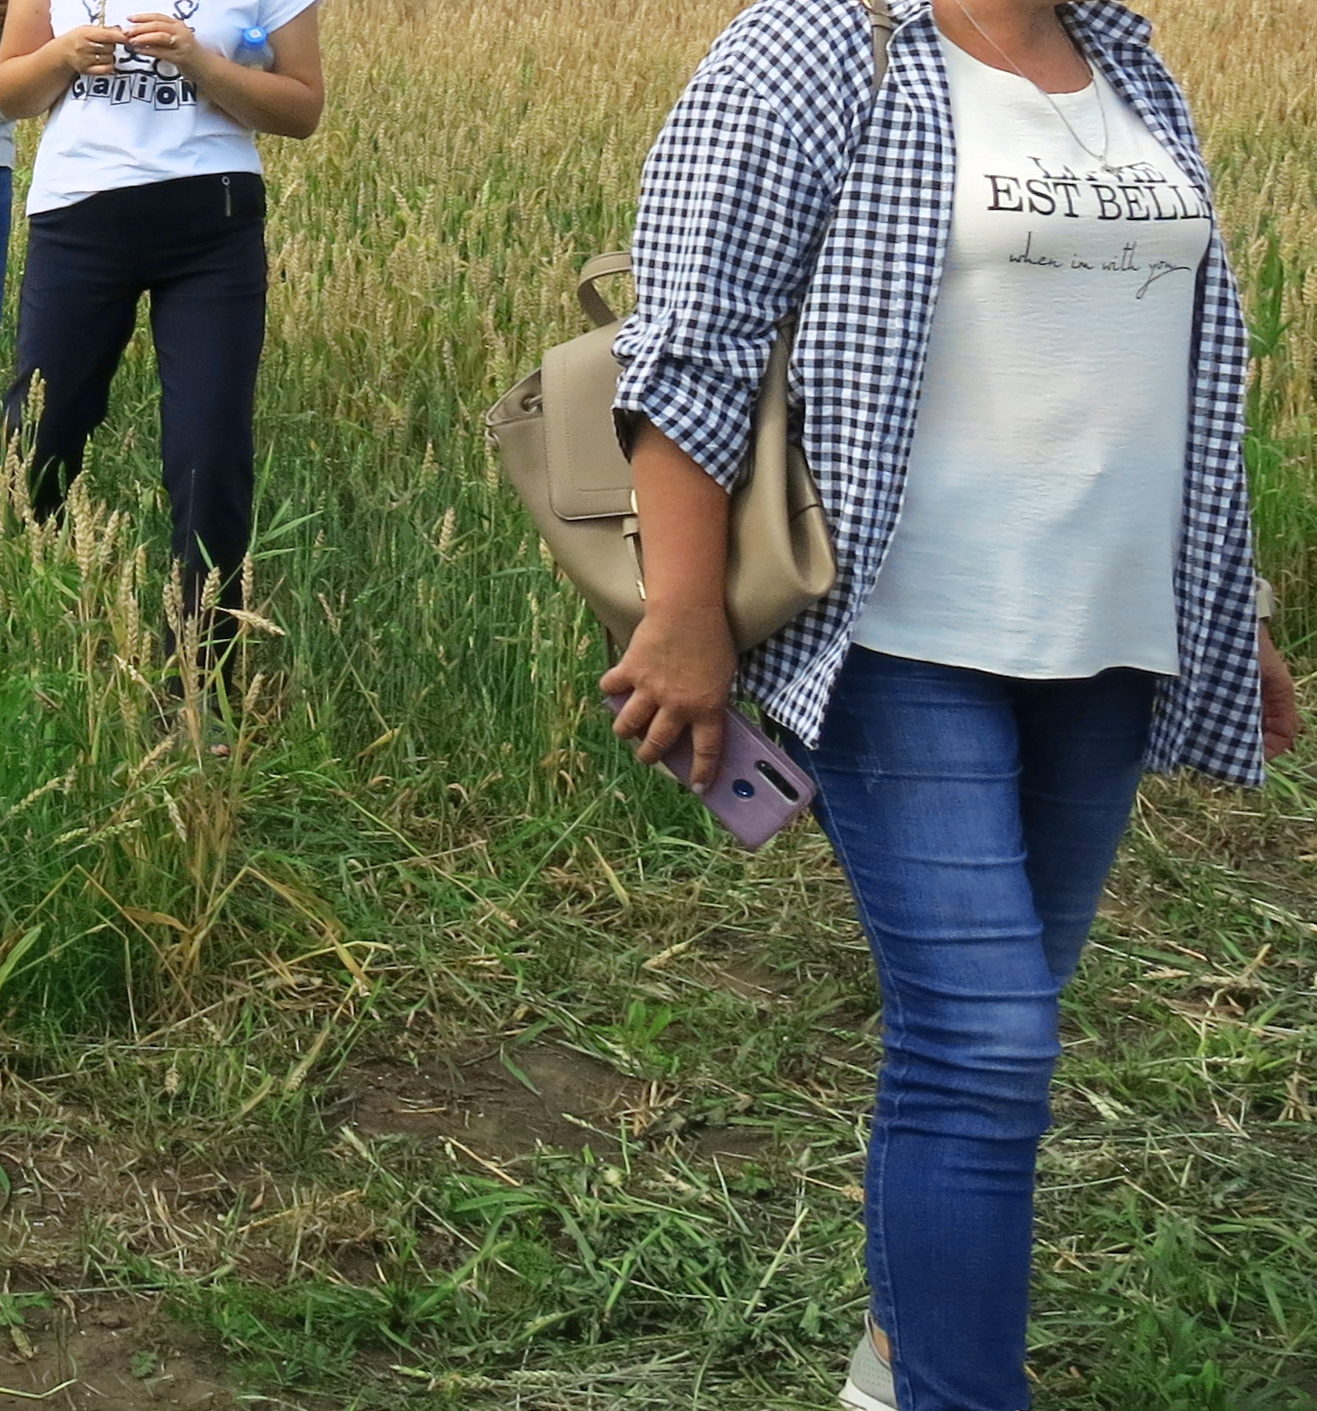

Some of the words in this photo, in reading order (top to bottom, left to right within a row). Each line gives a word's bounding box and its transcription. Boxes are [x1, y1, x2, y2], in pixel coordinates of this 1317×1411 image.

[983, 174, 1081, 218] EST
[1009, 231, 1062, 268] when
[1102, 241, 1139, 271] with
[1136, 260, 1191, 299] you
